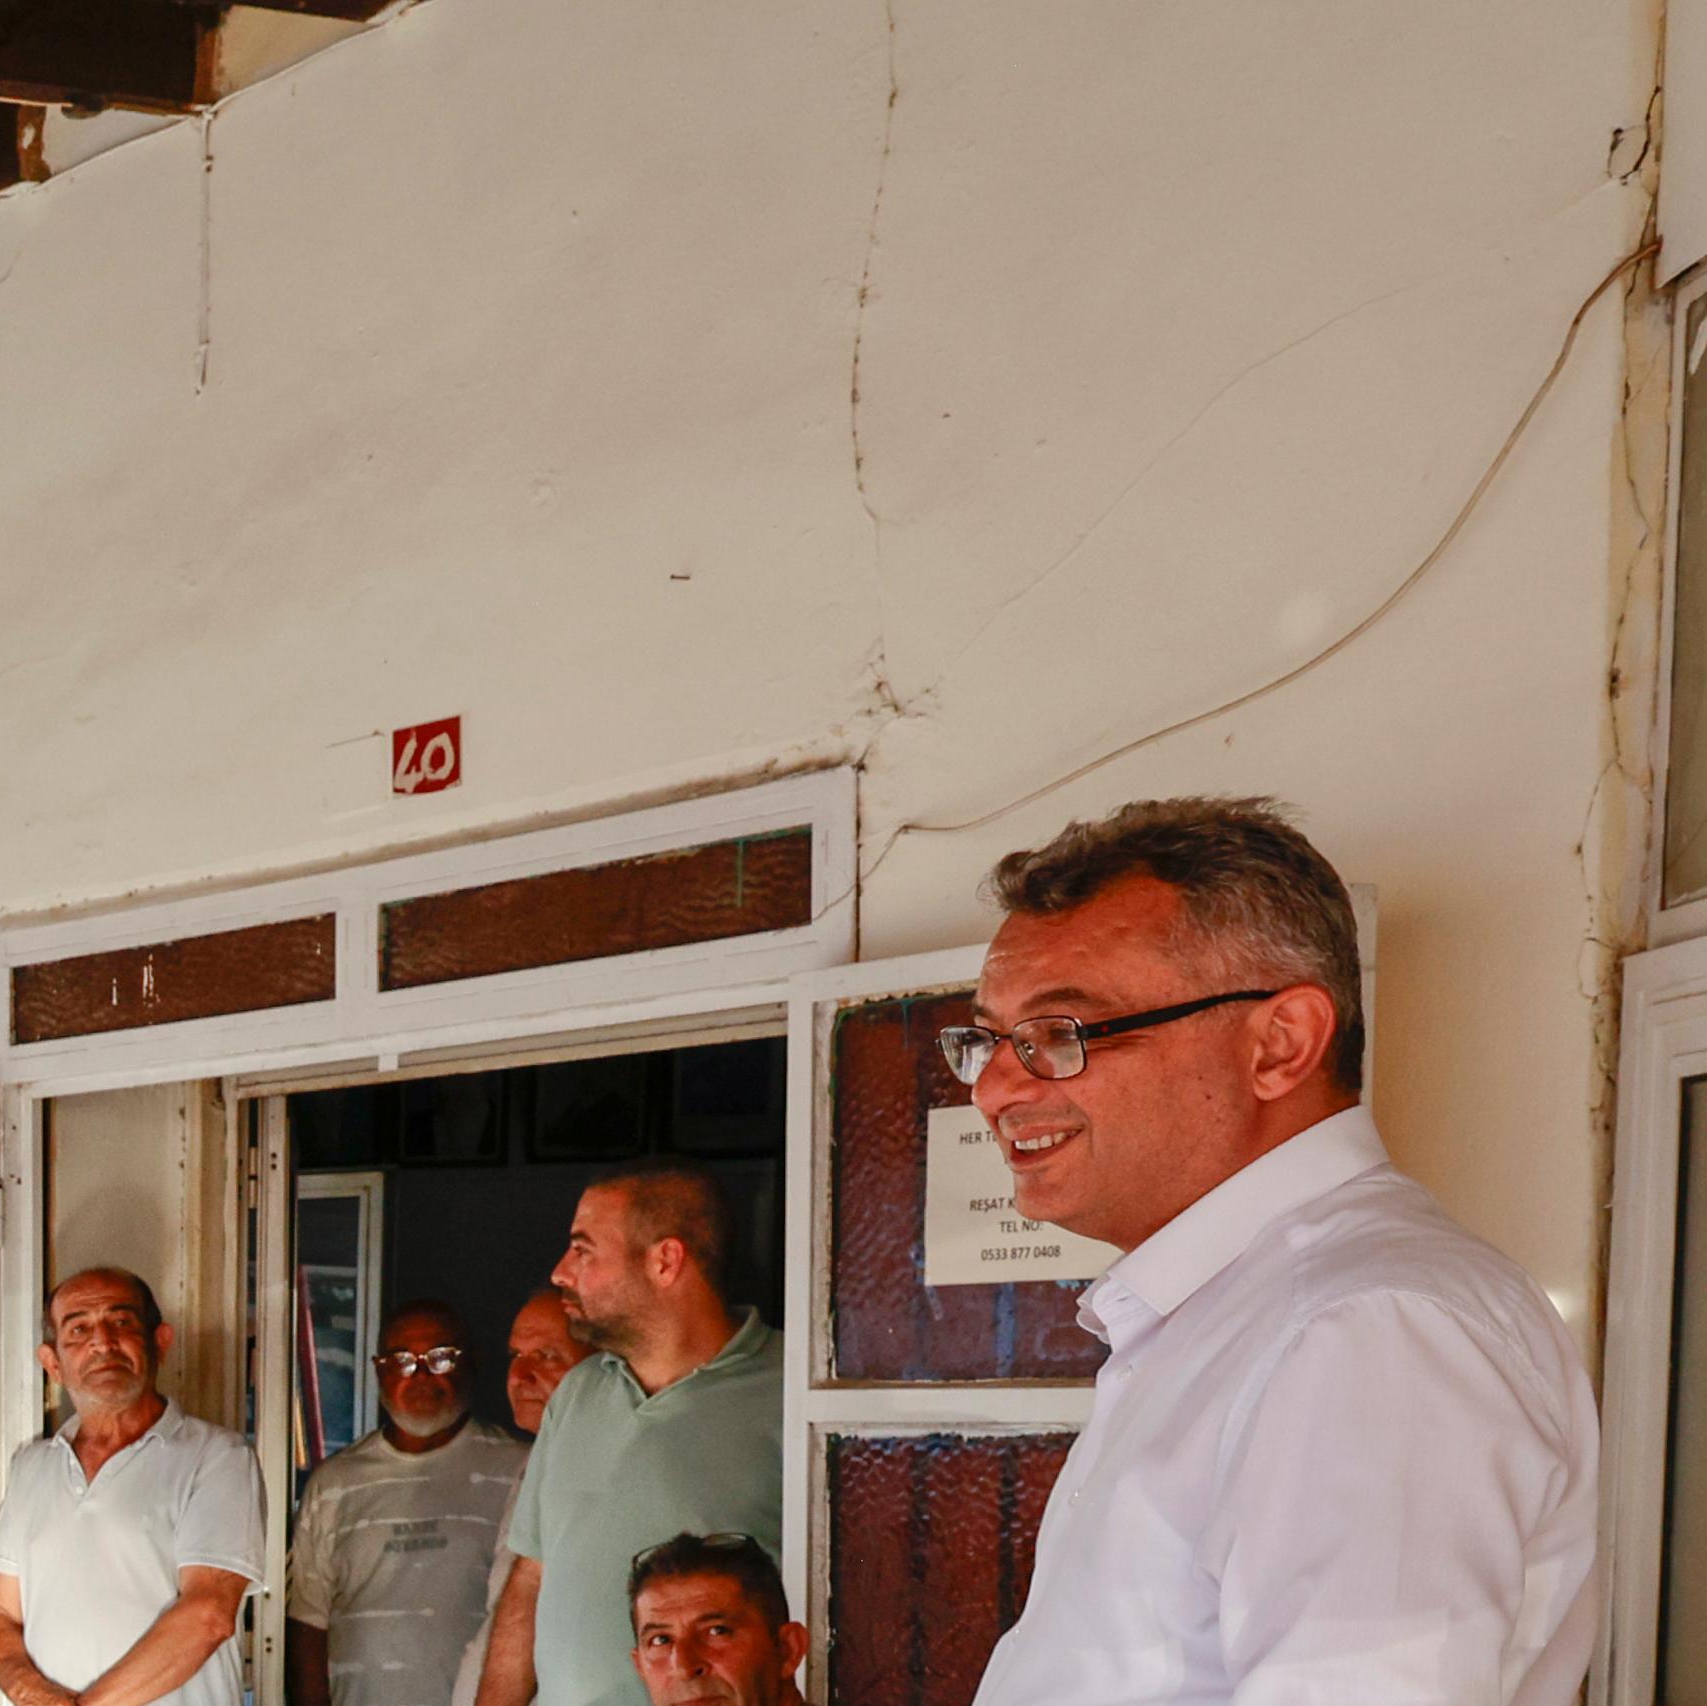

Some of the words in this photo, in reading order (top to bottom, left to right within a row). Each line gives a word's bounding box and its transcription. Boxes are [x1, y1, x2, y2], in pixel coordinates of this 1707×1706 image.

[959, 1131, 982, 1145] HER
[970, 1197, 1006, 1213] REŞAT
[1000, 1221, 1018, 1233] TEL
[981, 1249, 1007, 1261] 0533
[1011, 1247, 1031, 1259] 877
[1033, 1245, 1061, 1258] 0408
